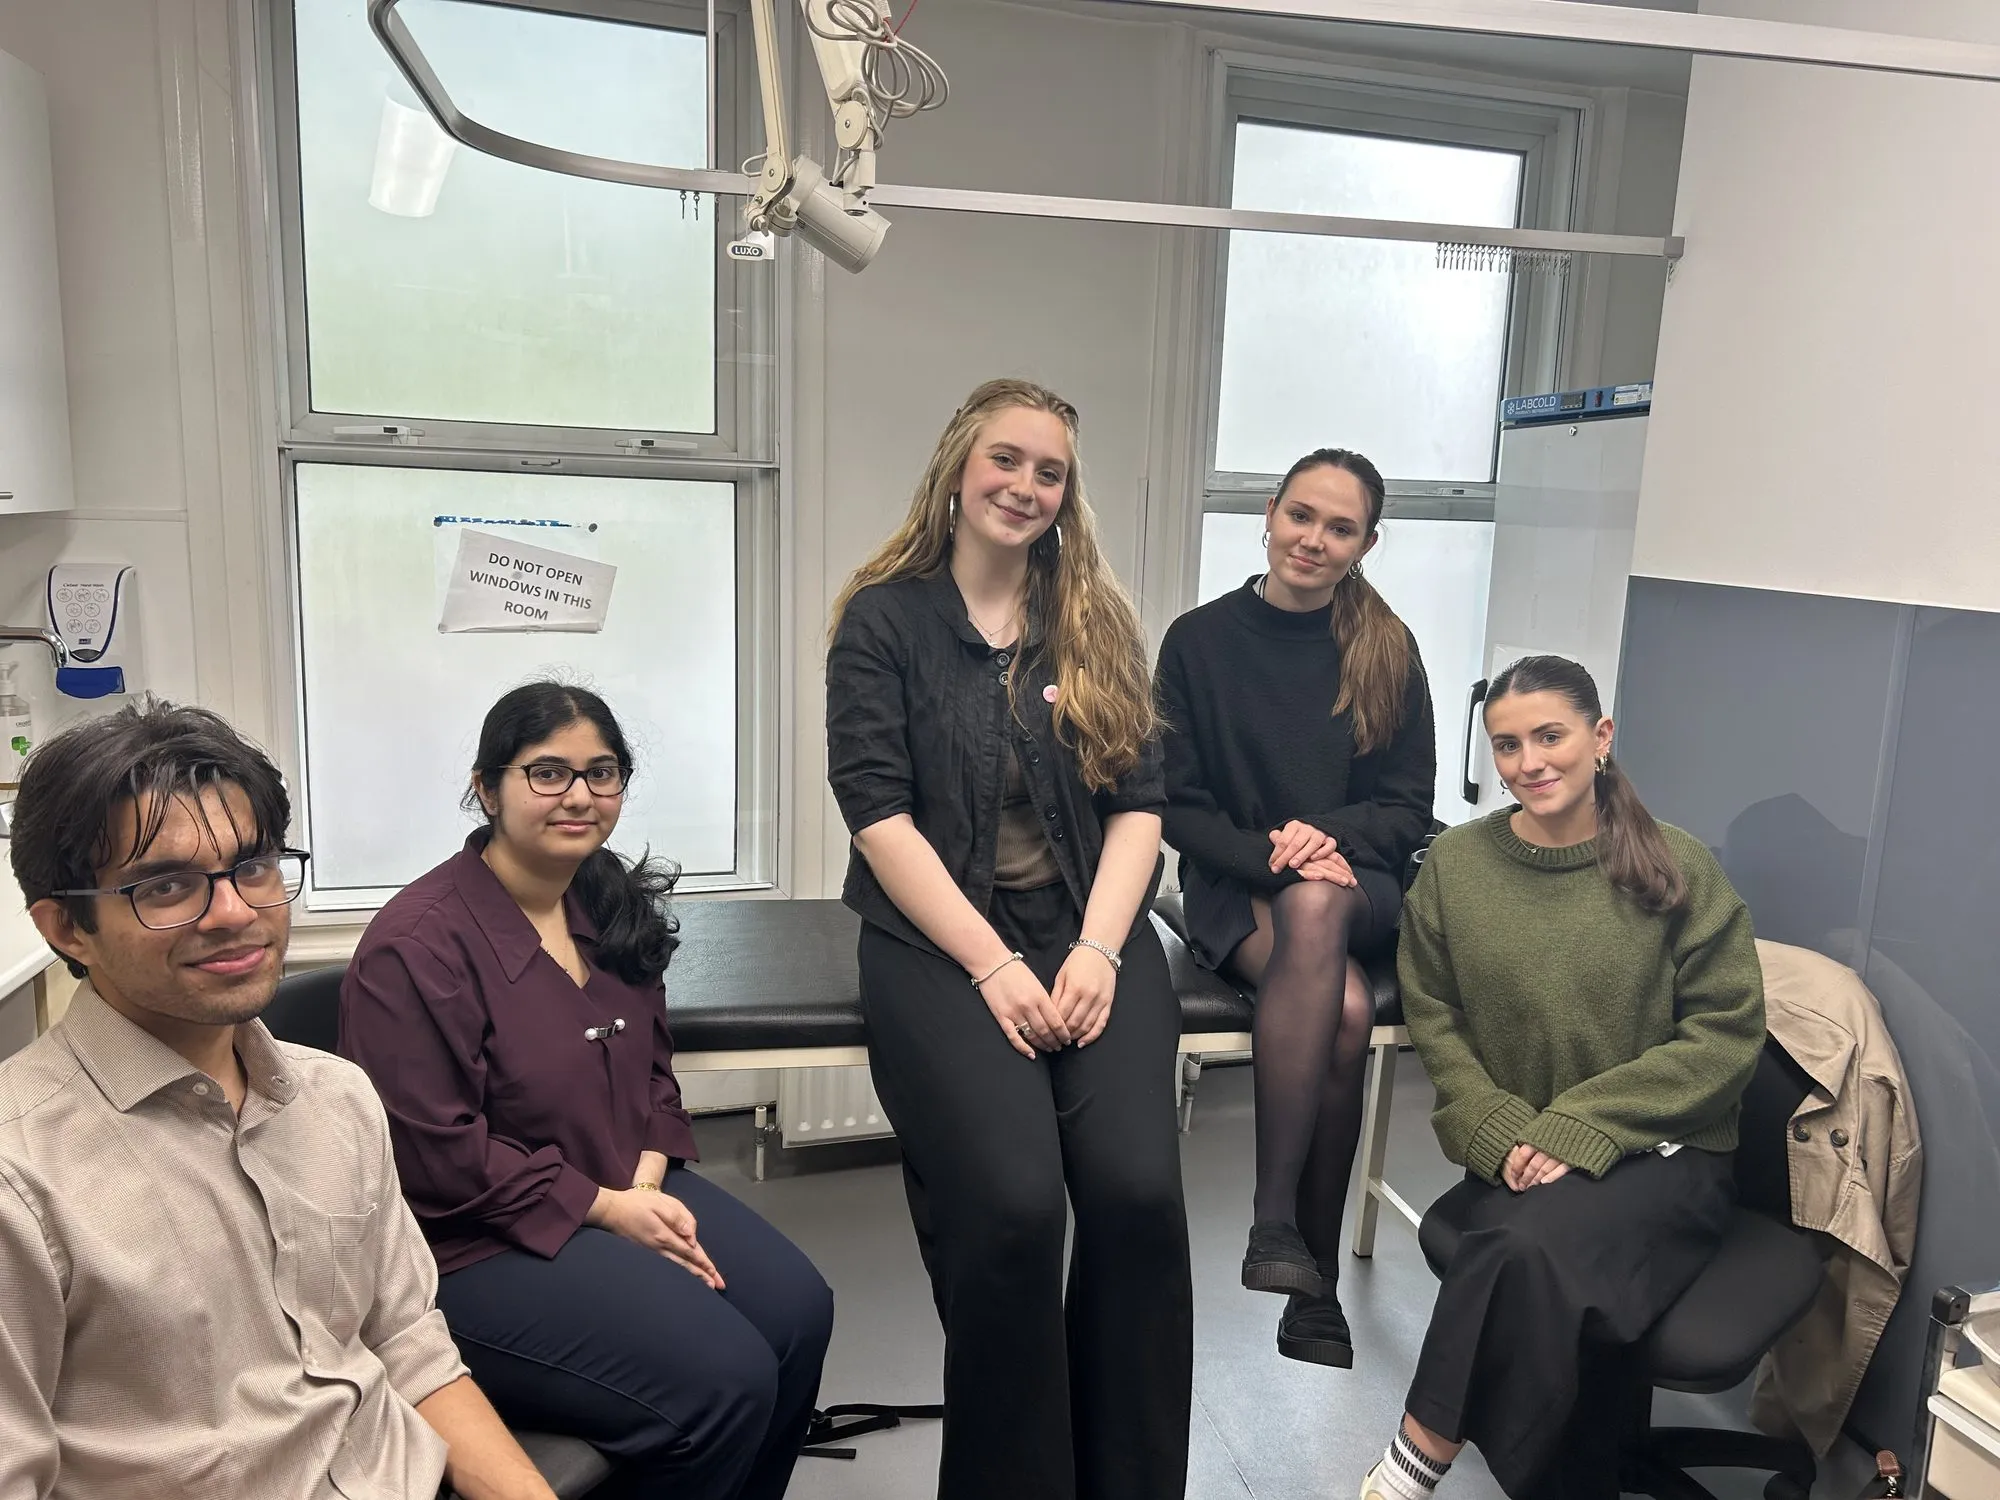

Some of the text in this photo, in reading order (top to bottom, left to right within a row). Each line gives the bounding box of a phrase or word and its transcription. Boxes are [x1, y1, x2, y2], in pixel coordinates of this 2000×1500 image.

[735, 246, 759, 255] LUXO
[1515, 396, 1556, 410] LABCOLD
[488, 552, 583, 586] DO NOT OPEN
[470, 570, 592, 610] WINDOWS IN THIS
[504, 601, 549, 621] ROOM
